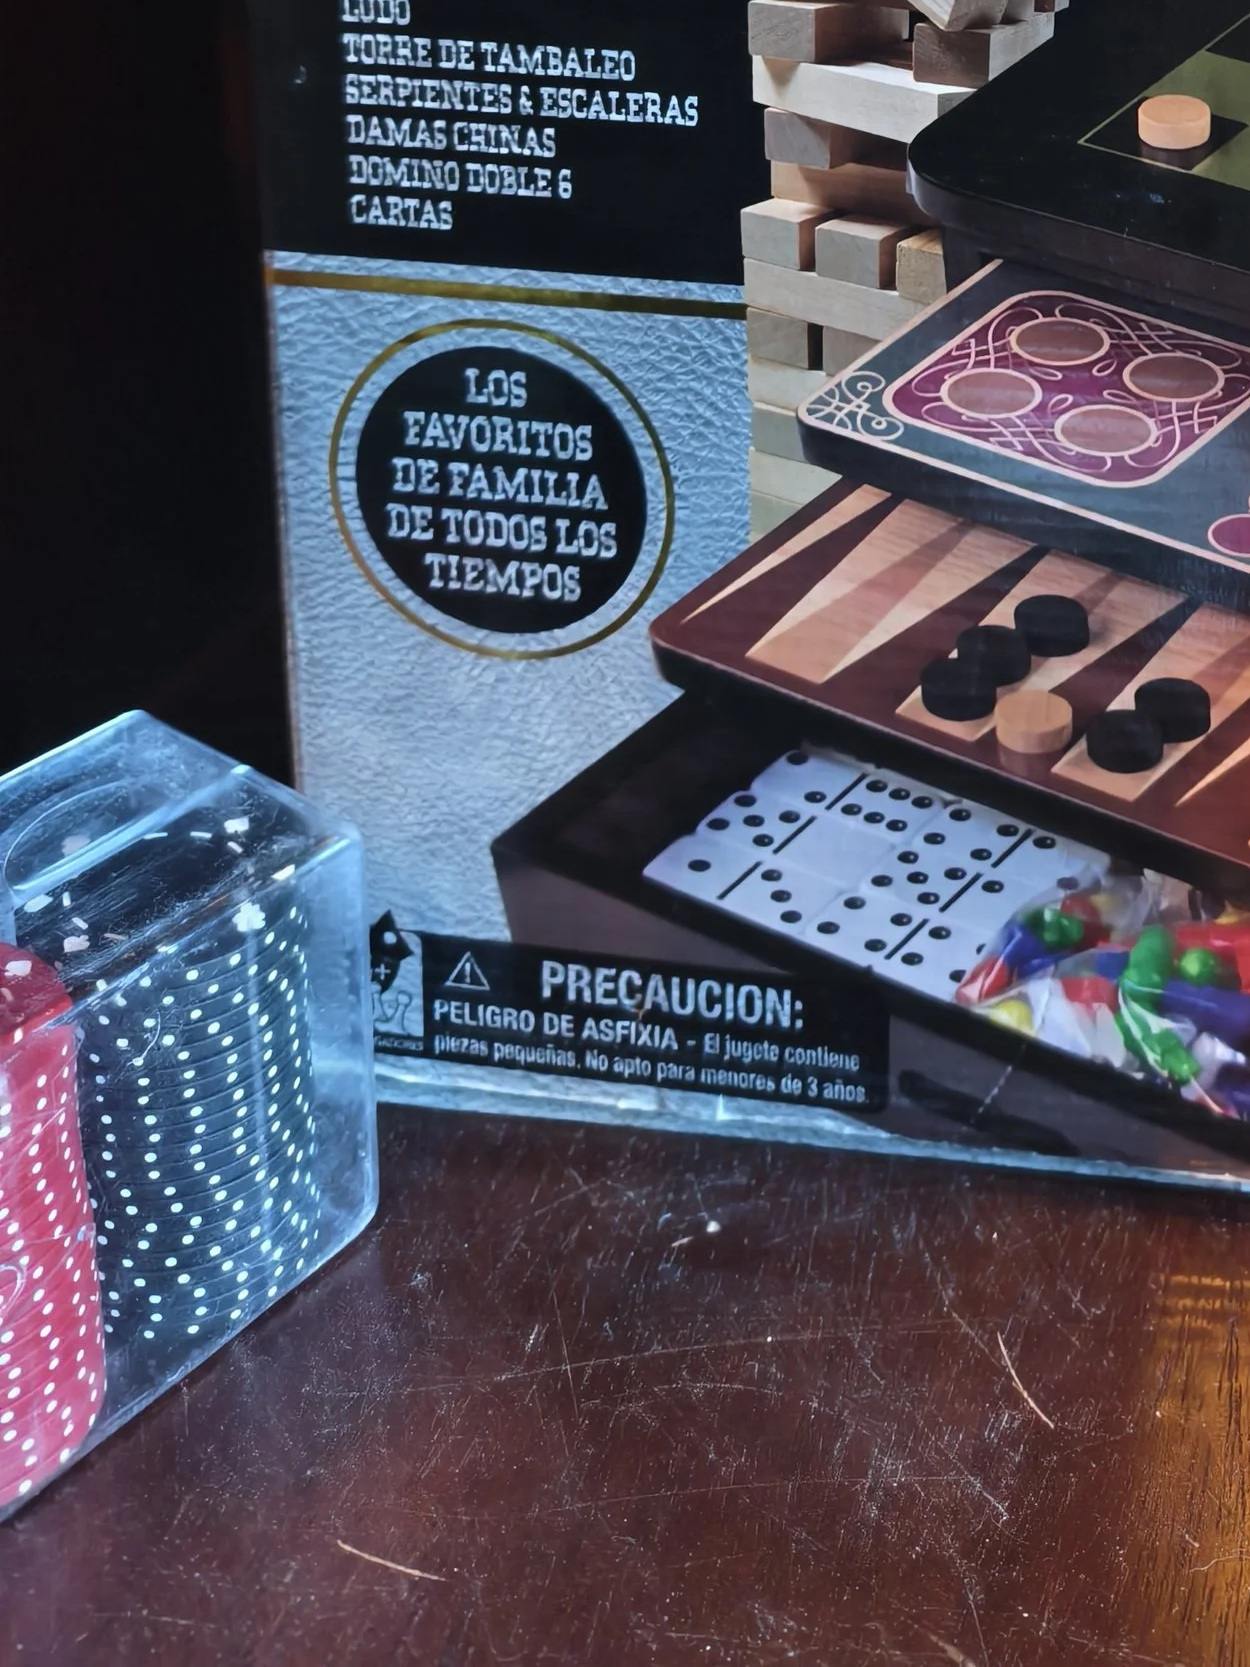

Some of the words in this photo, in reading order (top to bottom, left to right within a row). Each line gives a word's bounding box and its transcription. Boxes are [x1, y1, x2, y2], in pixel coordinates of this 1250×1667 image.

[342, 32, 432, 68] TORRE
[438, 39, 476, 71] DE
[481, 42, 636, 82] TAMBALEO
[344, 73, 512, 114] SERPIENTES
[519, 84, 534, 116] &
[540, 86, 699, 127] ESCALERAS
[345, 114, 447, 151] DAMAS
[452, 122, 556, 158] CHINAS
[347, 155, 460, 191] DOMINO
[465, 162, 552, 197] DOBLE
[558, 168, 572, 199] 6
[349, 193, 454, 231] CARTAS
[464, 367, 528, 408] LOS
[403, 410, 594, 462] FAVORITOS
[391, 456, 440, 495] DE
[447, 462, 609, 511] FAMILIA
[385, 502, 435, 541] DE
[441, 507, 547, 553] TODOS
[556, 518, 618, 559] LOS
[424, 552, 582, 603] TIEMPOS
[541, 959, 805, 1029] PRECAUCION:
[434, 998, 536, 1033] PELIGRO
[543, 1011, 575, 1038] DE
[582, 1016, 679, 1050] ASFIXIA
[704, 1032, 720, 1055] El
[434, 1033, 489, 1056] piezas
[585, 1049, 609, 1072] No
[613, 1052, 652, 1078] apto
[657, 1061, 696, 1083] para
[701, 1067, 776, 1093] menores
[780, 1073, 802, 1096] de
[807, 1076, 818, 1098] 3
